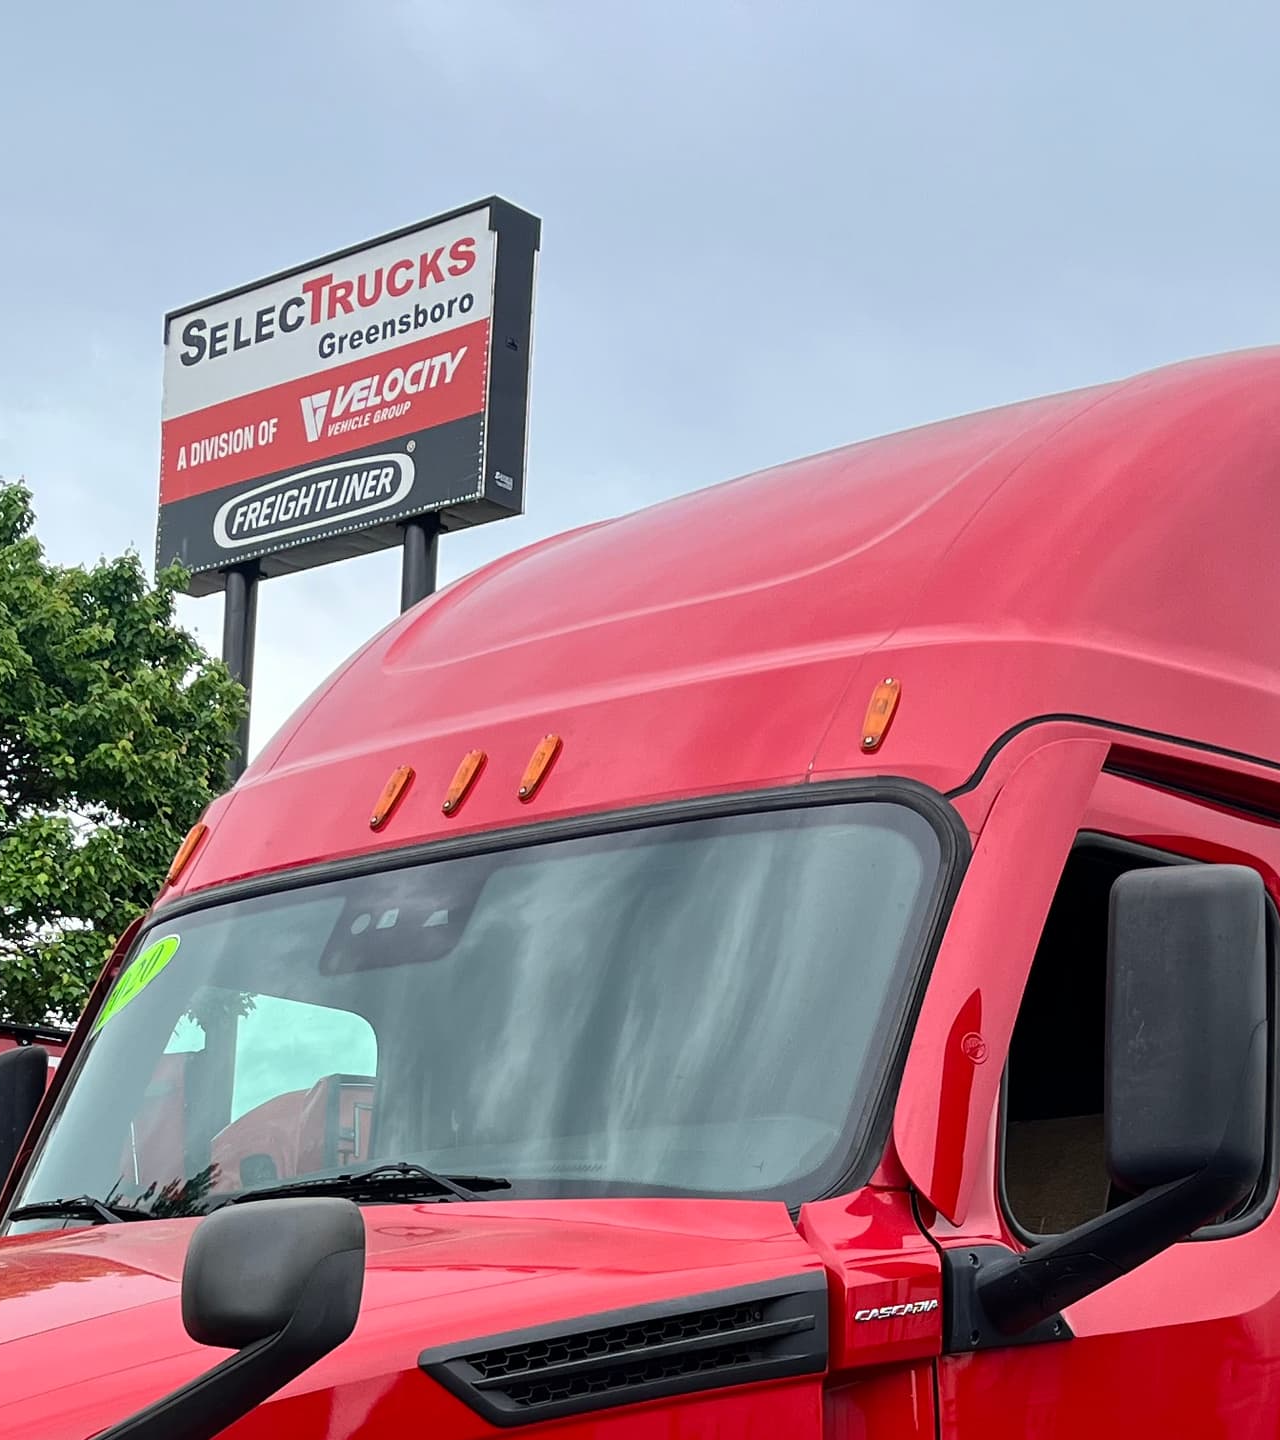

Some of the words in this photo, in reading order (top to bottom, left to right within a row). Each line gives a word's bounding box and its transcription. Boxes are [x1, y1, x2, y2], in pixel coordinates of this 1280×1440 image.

[180, 237, 476, 367] SELECTRUCKS
[318, 292, 475, 359] Greensboro
[330, 346, 469, 418] VELOCITY
[177, 446, 187, 471] A
[190, 428, 254, 468] DIVISION
[258, 418, 279, 448] OF
[327, 411, 370, 438] VEHICLE
[373, 401, 411, 427] GROUP
[230, 467, 395, 536] FREIGHTLINER
[854, 1299, 939, 1321] CASCADIA
